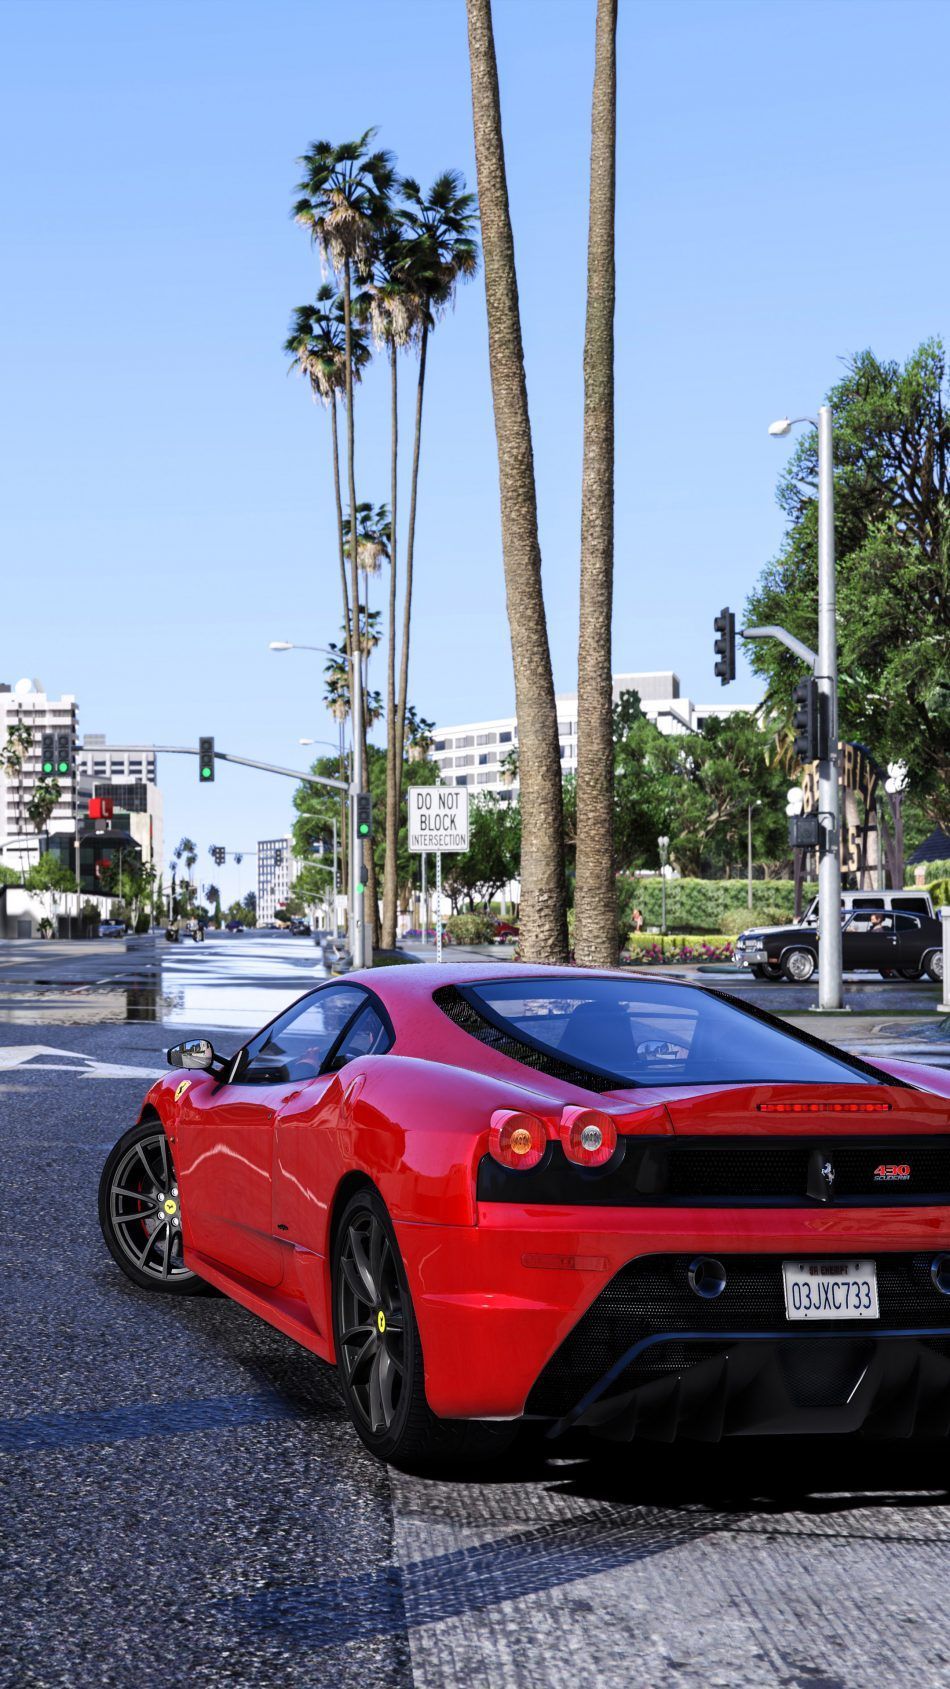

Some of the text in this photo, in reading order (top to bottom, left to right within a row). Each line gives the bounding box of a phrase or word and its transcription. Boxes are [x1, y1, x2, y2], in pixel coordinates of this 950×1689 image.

[802, 741, 876, 814] BERLY
[417, 793, 460, 810] DO NOT
[420, 814, 457, 831] BLOCK
[411, 834, 466, 846] INTERSECTION
[873, 1165, 911, 1176] 430
[792, 1281, 872, 1310] 03JXC733
